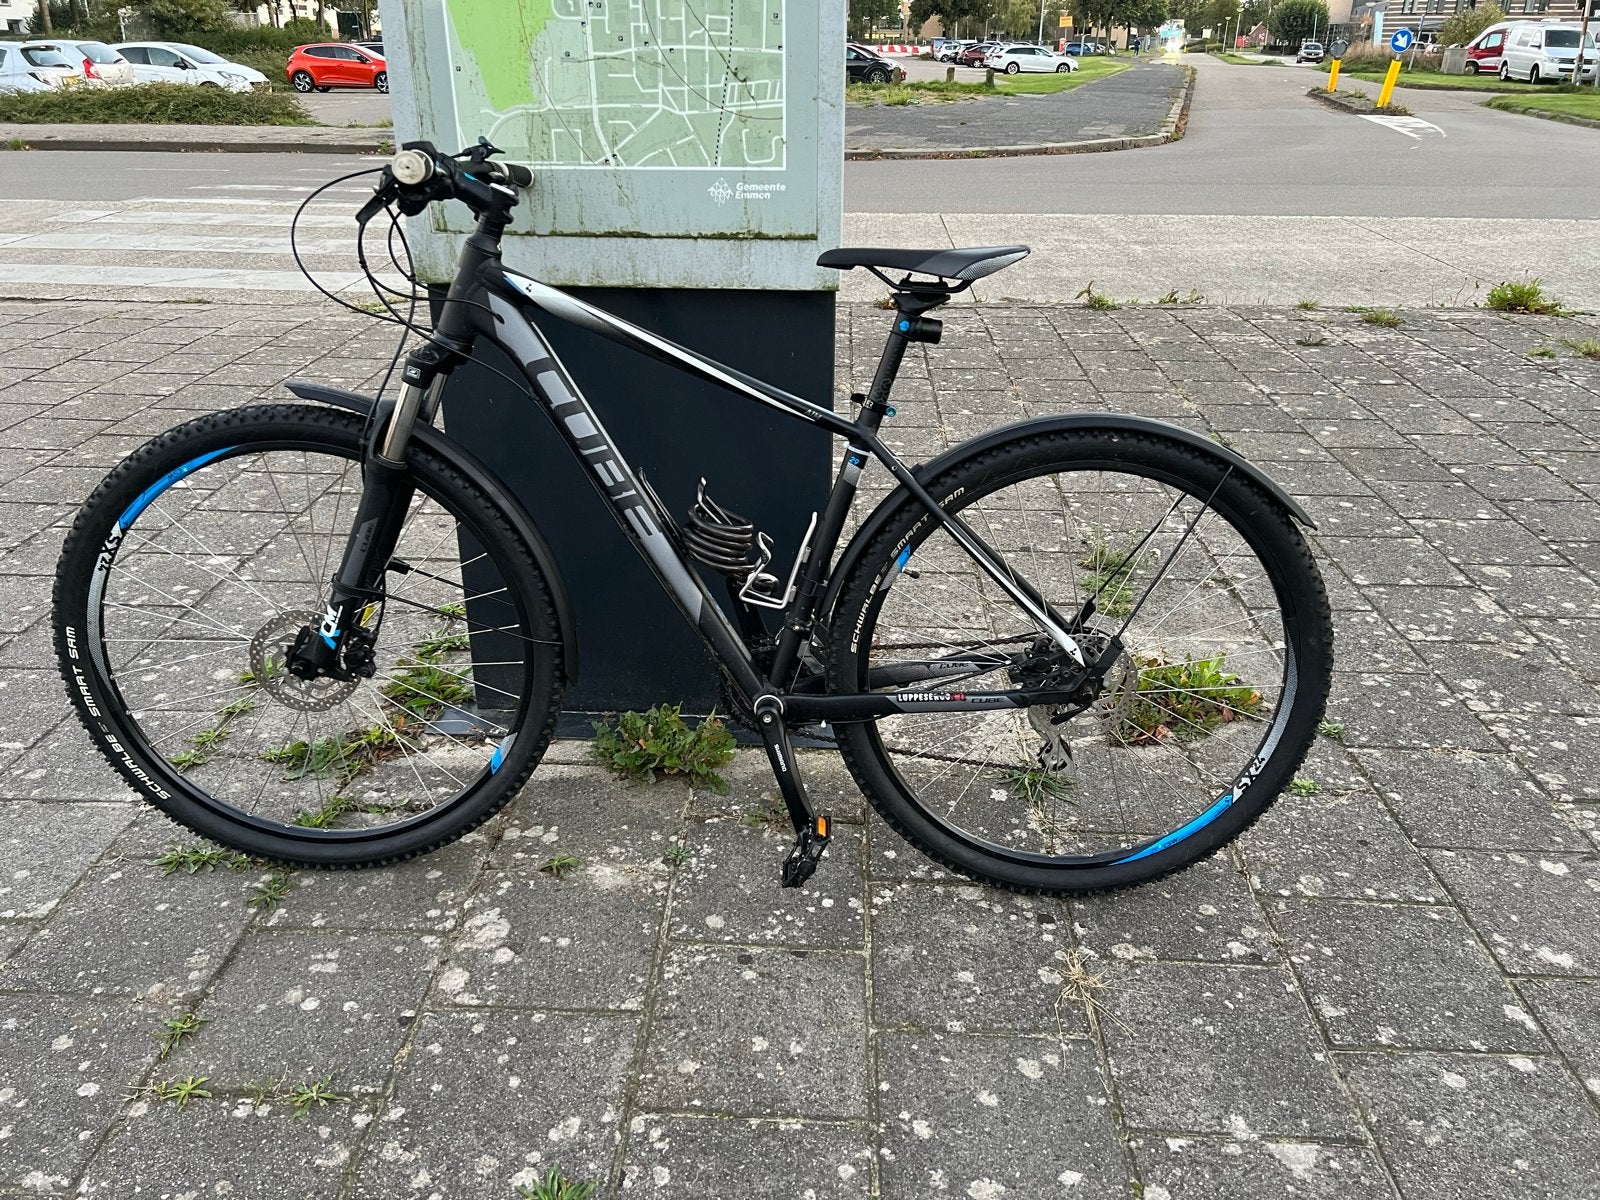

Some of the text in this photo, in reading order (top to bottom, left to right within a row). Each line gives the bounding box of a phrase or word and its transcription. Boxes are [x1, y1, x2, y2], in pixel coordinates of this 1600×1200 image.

[736, 182, 786, 191] Gemeente
[526, 357, 657, 540] CUBE
[851, 574, 883, 653] SCHWALBE
[890, 513, 930, 559] SMART
[66, 626, 172, 800] SCHWALBE SMART SAM
[774, 744, 787, 772] SHIMANO
